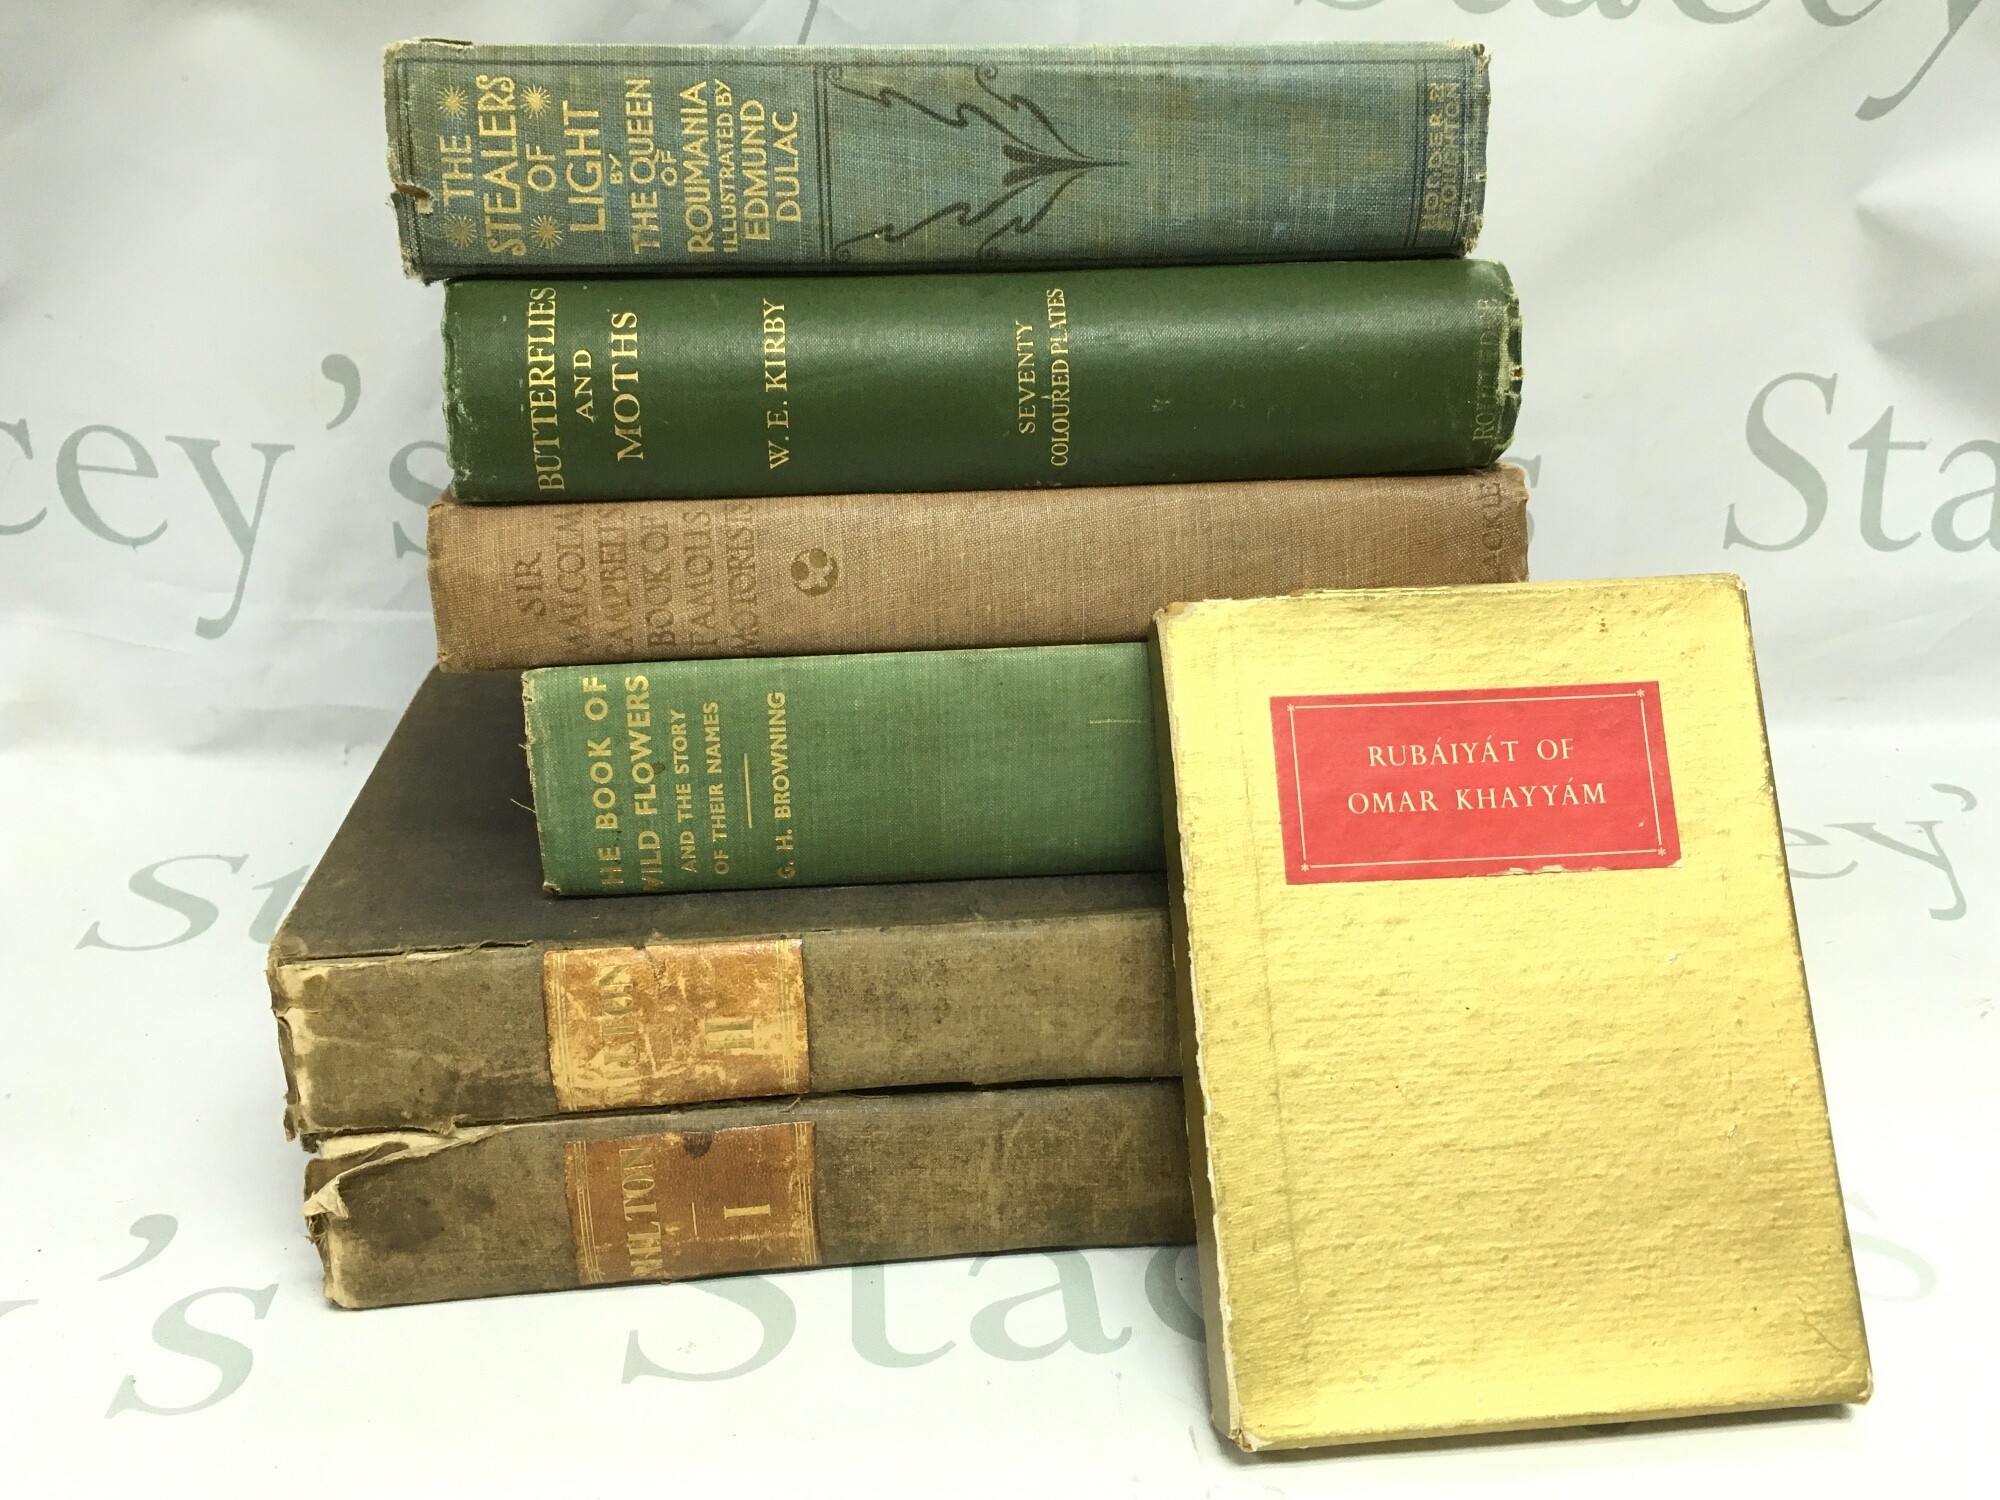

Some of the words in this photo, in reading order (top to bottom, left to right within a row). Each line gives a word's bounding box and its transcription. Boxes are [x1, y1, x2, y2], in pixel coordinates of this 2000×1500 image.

[714, 79, 733, 107] BY
[625, 79, 661, 184] QUEEN
[439, 135, 472, 205] THE
[476, 74, 525, 257] STEALERS
[526, 144, 557, 192] OF
[562, 101, 606, 233] LIGHT
[608, 154, 625, 184] BY
[660, 150, 679, 187] OF
[680, 81, 715, 253] ROUMANIA
[716, 114, 738, 253] ILLUSTRATED
[739, 99, 771, 241] EDMUND
[772, 111, 801, 222] DULAC
[630, 191, 660, 255] THE
[763, 298, 787, 392] KIRBY
[1046, 288, 1069, 355] PLATES
[527, 287, 565, 492] BUTTERFLIES
[573, 350, 594, 422] AND
[611, 311, 644, 462] MOTHS
[1016, 320, 1036, 434] SEVENTY
[766, 400, 790, 429] E.
[1050, 359, 1070, 467] COLOURED
[769, 436, 790, 469] W.
[640, 515, 669, 552] OF
[514, 551, 543, 617] SIR
[643, 560, 676, 647] BOOK
[683, 511, 718, 651] FAMOUS
[582, 676, 608, 720] OF
[625, 674, 658, 815] FLOWERS
[669, 708, 690, 774] STORY
[703, 701, 722, 773] NAMES
[767, 692, 791, 818] BROWNING
[1368, 735, 1518, 767] RUBÁIYÁT
[1536, 738, 1574, 761] OF
[587, 737, 618, 829] BOOK
[676, 783, 693, 823] THE
[708, 783, 727, 842] THEIR
[1347, 789, 1439, 815] OMAR
[1456, 777, 1607, 810] KHAYYÁM
[679, 830, 697, 873] AND
[714, 849, 729, 874] OF
[775, 829, 793, 851] H.
[778, 861, 795, 879] G.
[724, 1204, 771, 1220] I
